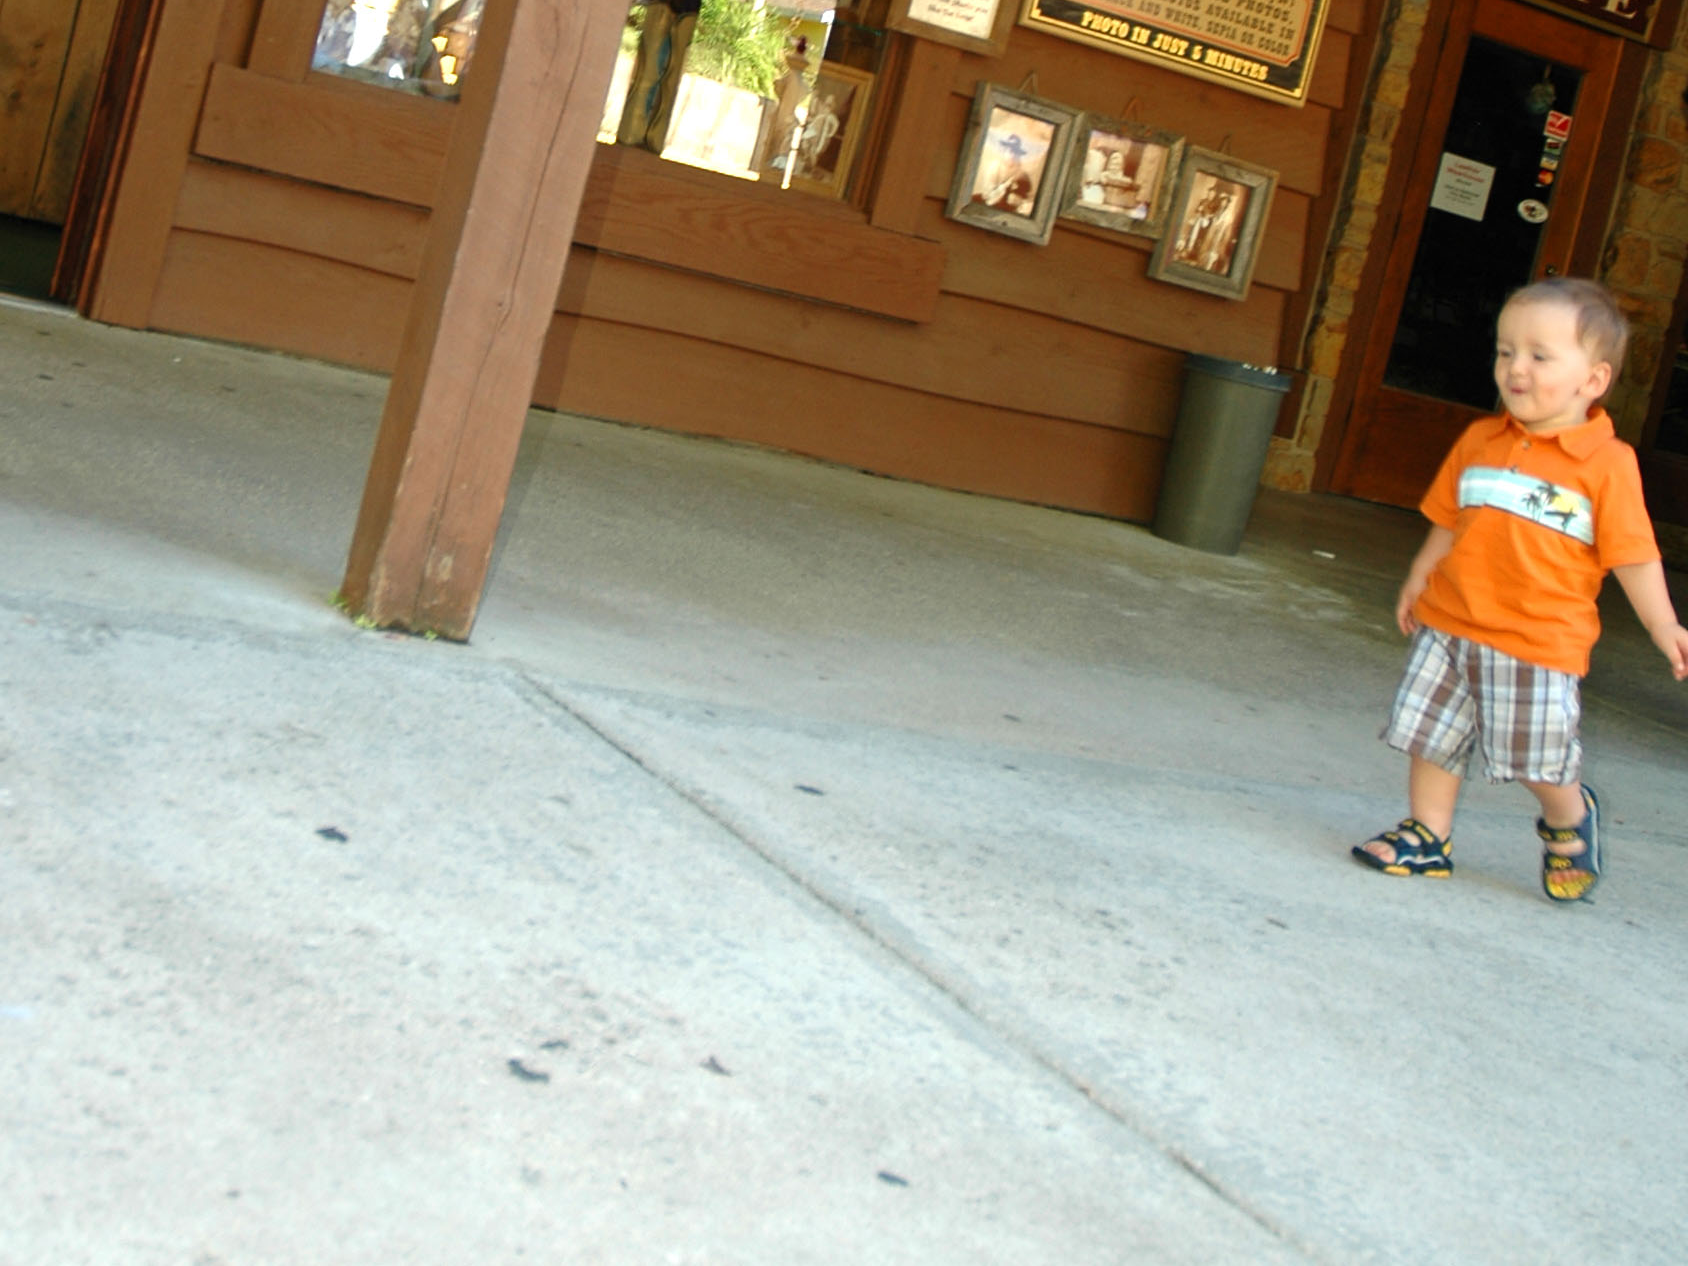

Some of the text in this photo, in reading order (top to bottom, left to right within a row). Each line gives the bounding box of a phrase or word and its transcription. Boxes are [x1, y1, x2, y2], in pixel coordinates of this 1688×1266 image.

[1081, 11, 1268, 80] PHOTO IN JUST 5 MINUTES
[1138, 0, 1160, 16] AND
[1206, 20, 1236, 40] SEPIA
[1240, 31, 1254, 45] OR
[1258, 36, 1289, 56] COLOR
[1205, 4, 1275, 34] AVAILABLE
[1279, 26, 1295, 40] IN
